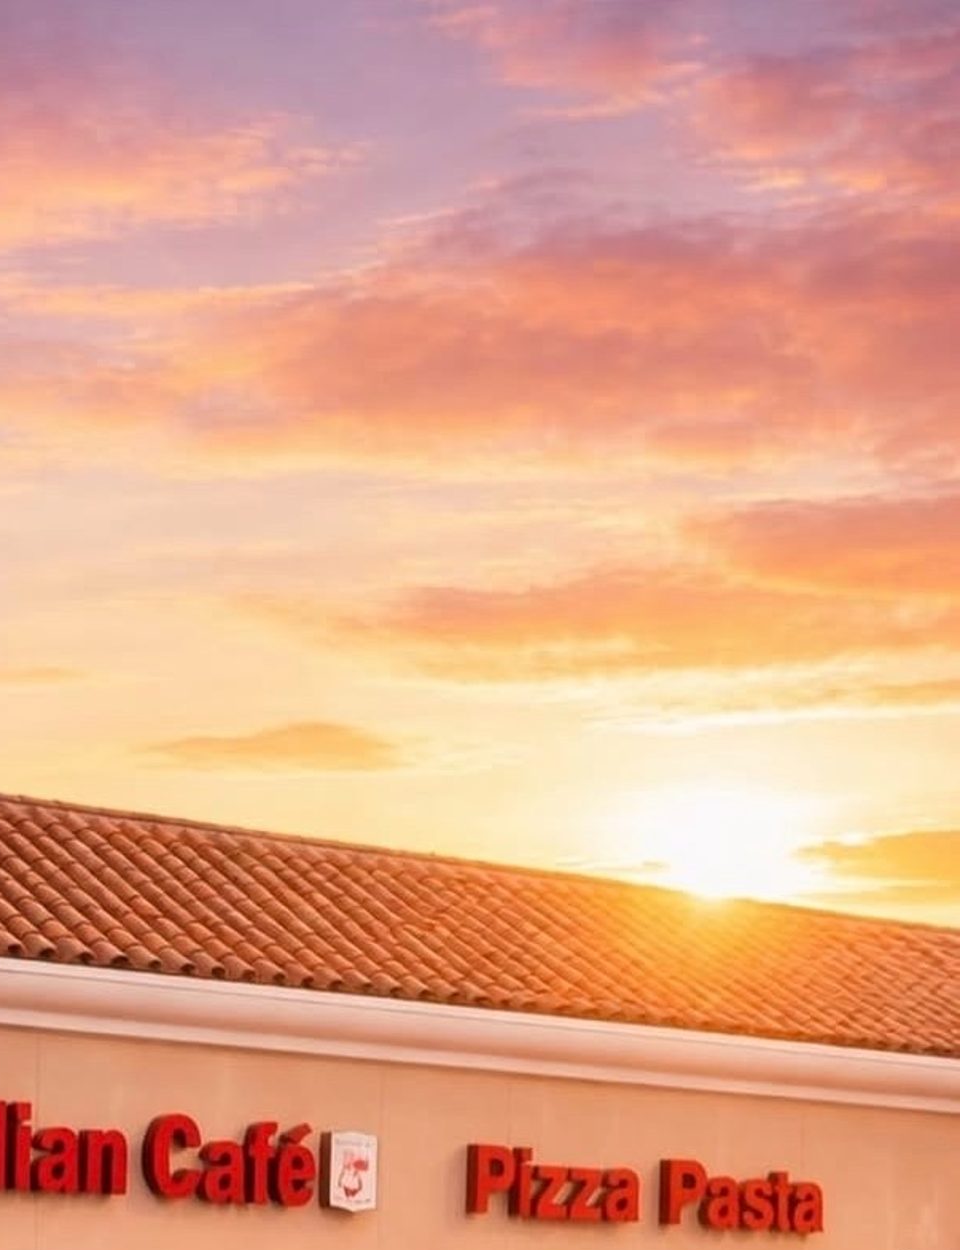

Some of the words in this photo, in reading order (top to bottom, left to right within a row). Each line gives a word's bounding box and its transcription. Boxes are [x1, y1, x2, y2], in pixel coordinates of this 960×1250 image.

[142, 1113, 317, 1208] Café
[466, 1144, 639, 1223] Pizza
[658, 1158, 824, 1234] Pasta
